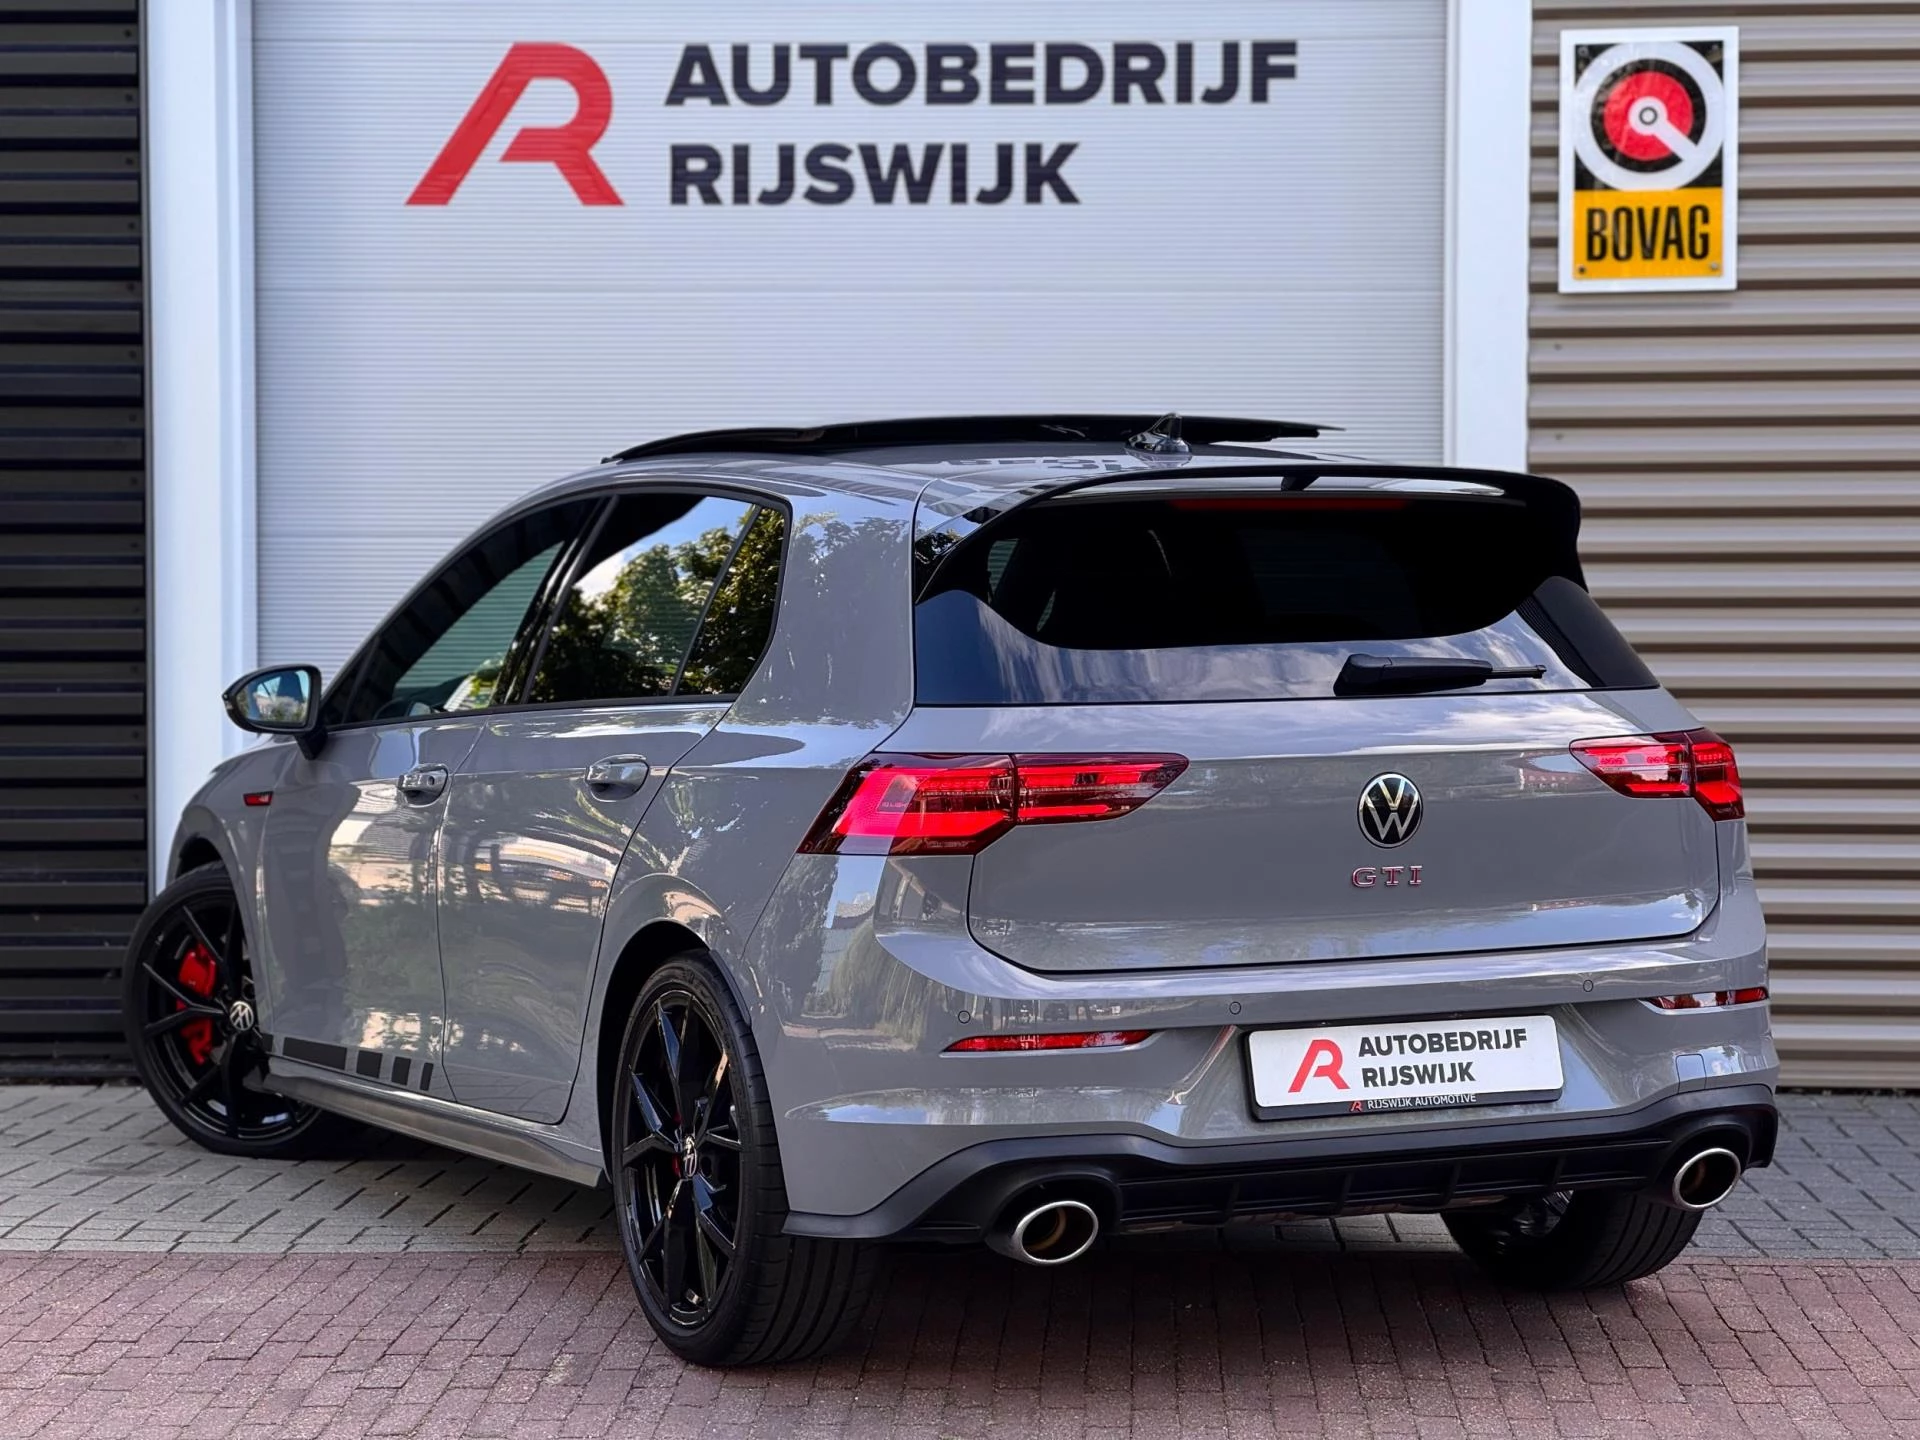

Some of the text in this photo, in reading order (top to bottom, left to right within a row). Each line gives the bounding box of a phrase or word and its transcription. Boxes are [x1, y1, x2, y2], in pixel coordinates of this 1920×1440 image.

[665, 40, 1298, 107] AUTOBEDRIJF
[669, 142, 1080, 206] RIJSWIJK
[1586, 204, 1710, 262] BOVAG
[1352, 865, 1423, 888] GTI
[1357, 1027, 1527, 1058] AUTOBEDRIJF
[1361, 1061, 1476, 1088] RIJSWIJK
[1367, 1097, 1413, 1110] RIJSWIJK
[1415, 1094, 1477, 1106] AUTOMOTIVE
